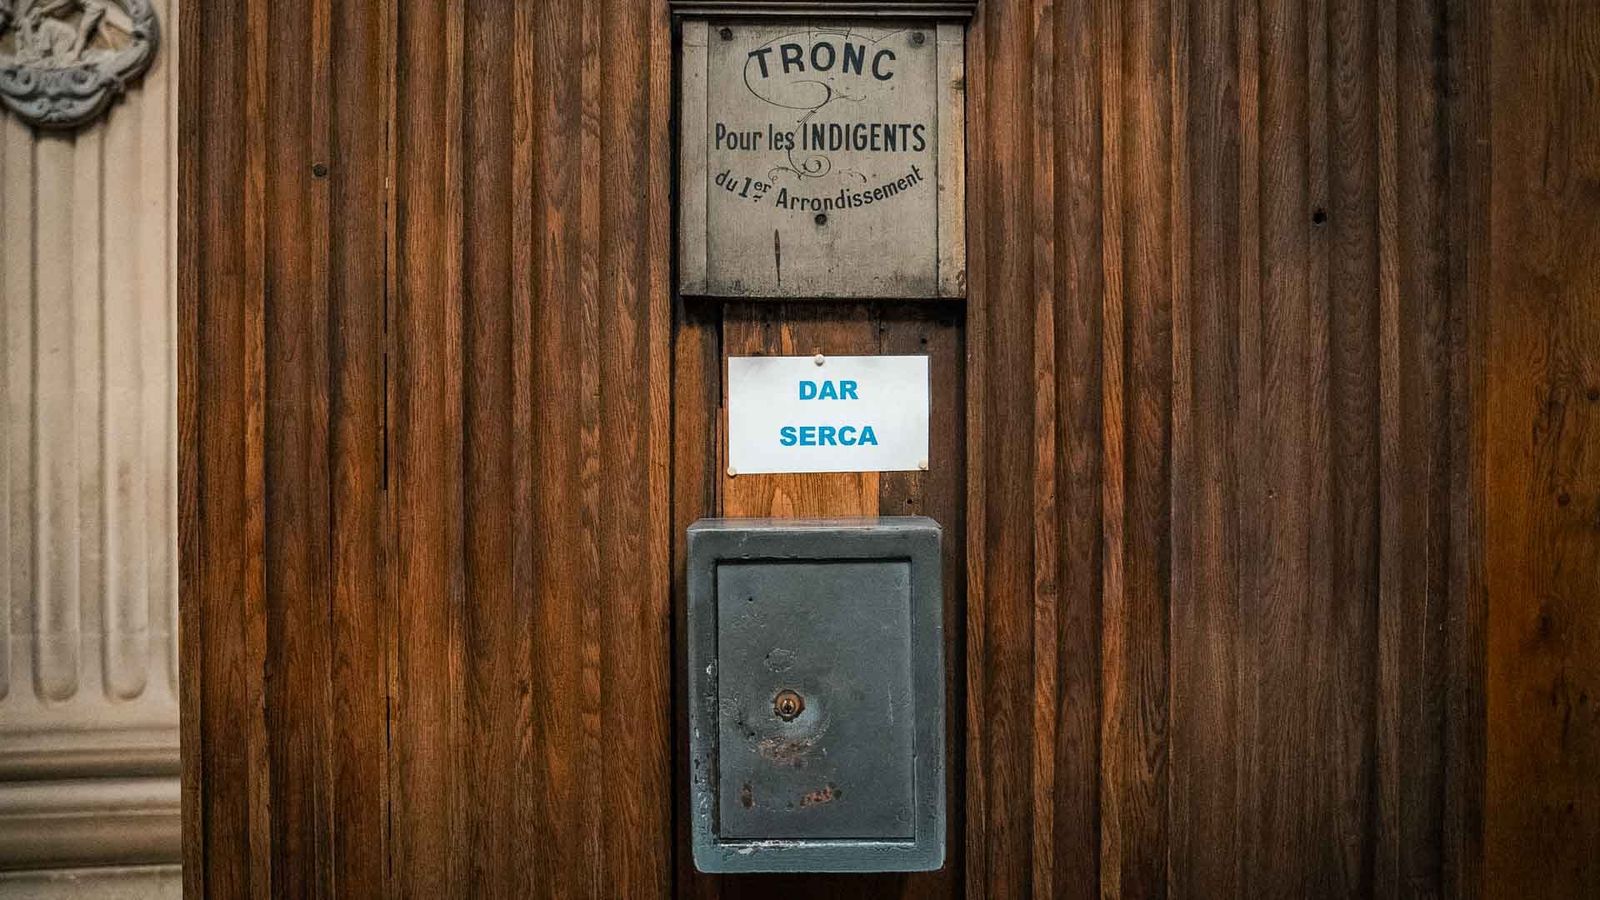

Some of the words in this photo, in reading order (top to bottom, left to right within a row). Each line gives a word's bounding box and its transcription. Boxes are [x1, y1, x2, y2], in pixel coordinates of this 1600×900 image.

[748, 41, 896, 81] TRONC
[715, 123, 763, 151] Pour
[768, 123, 796, 151] les
[802, 123, 926, 152] INDIGENTS
[715, 169, 738, 192] du
[738, 176, 771, 202] 1er
[776, 165, 923, 211] Arrondissement
[799, 380, 859, 400] DAR
[779, 426, 878, 447] SERCA
